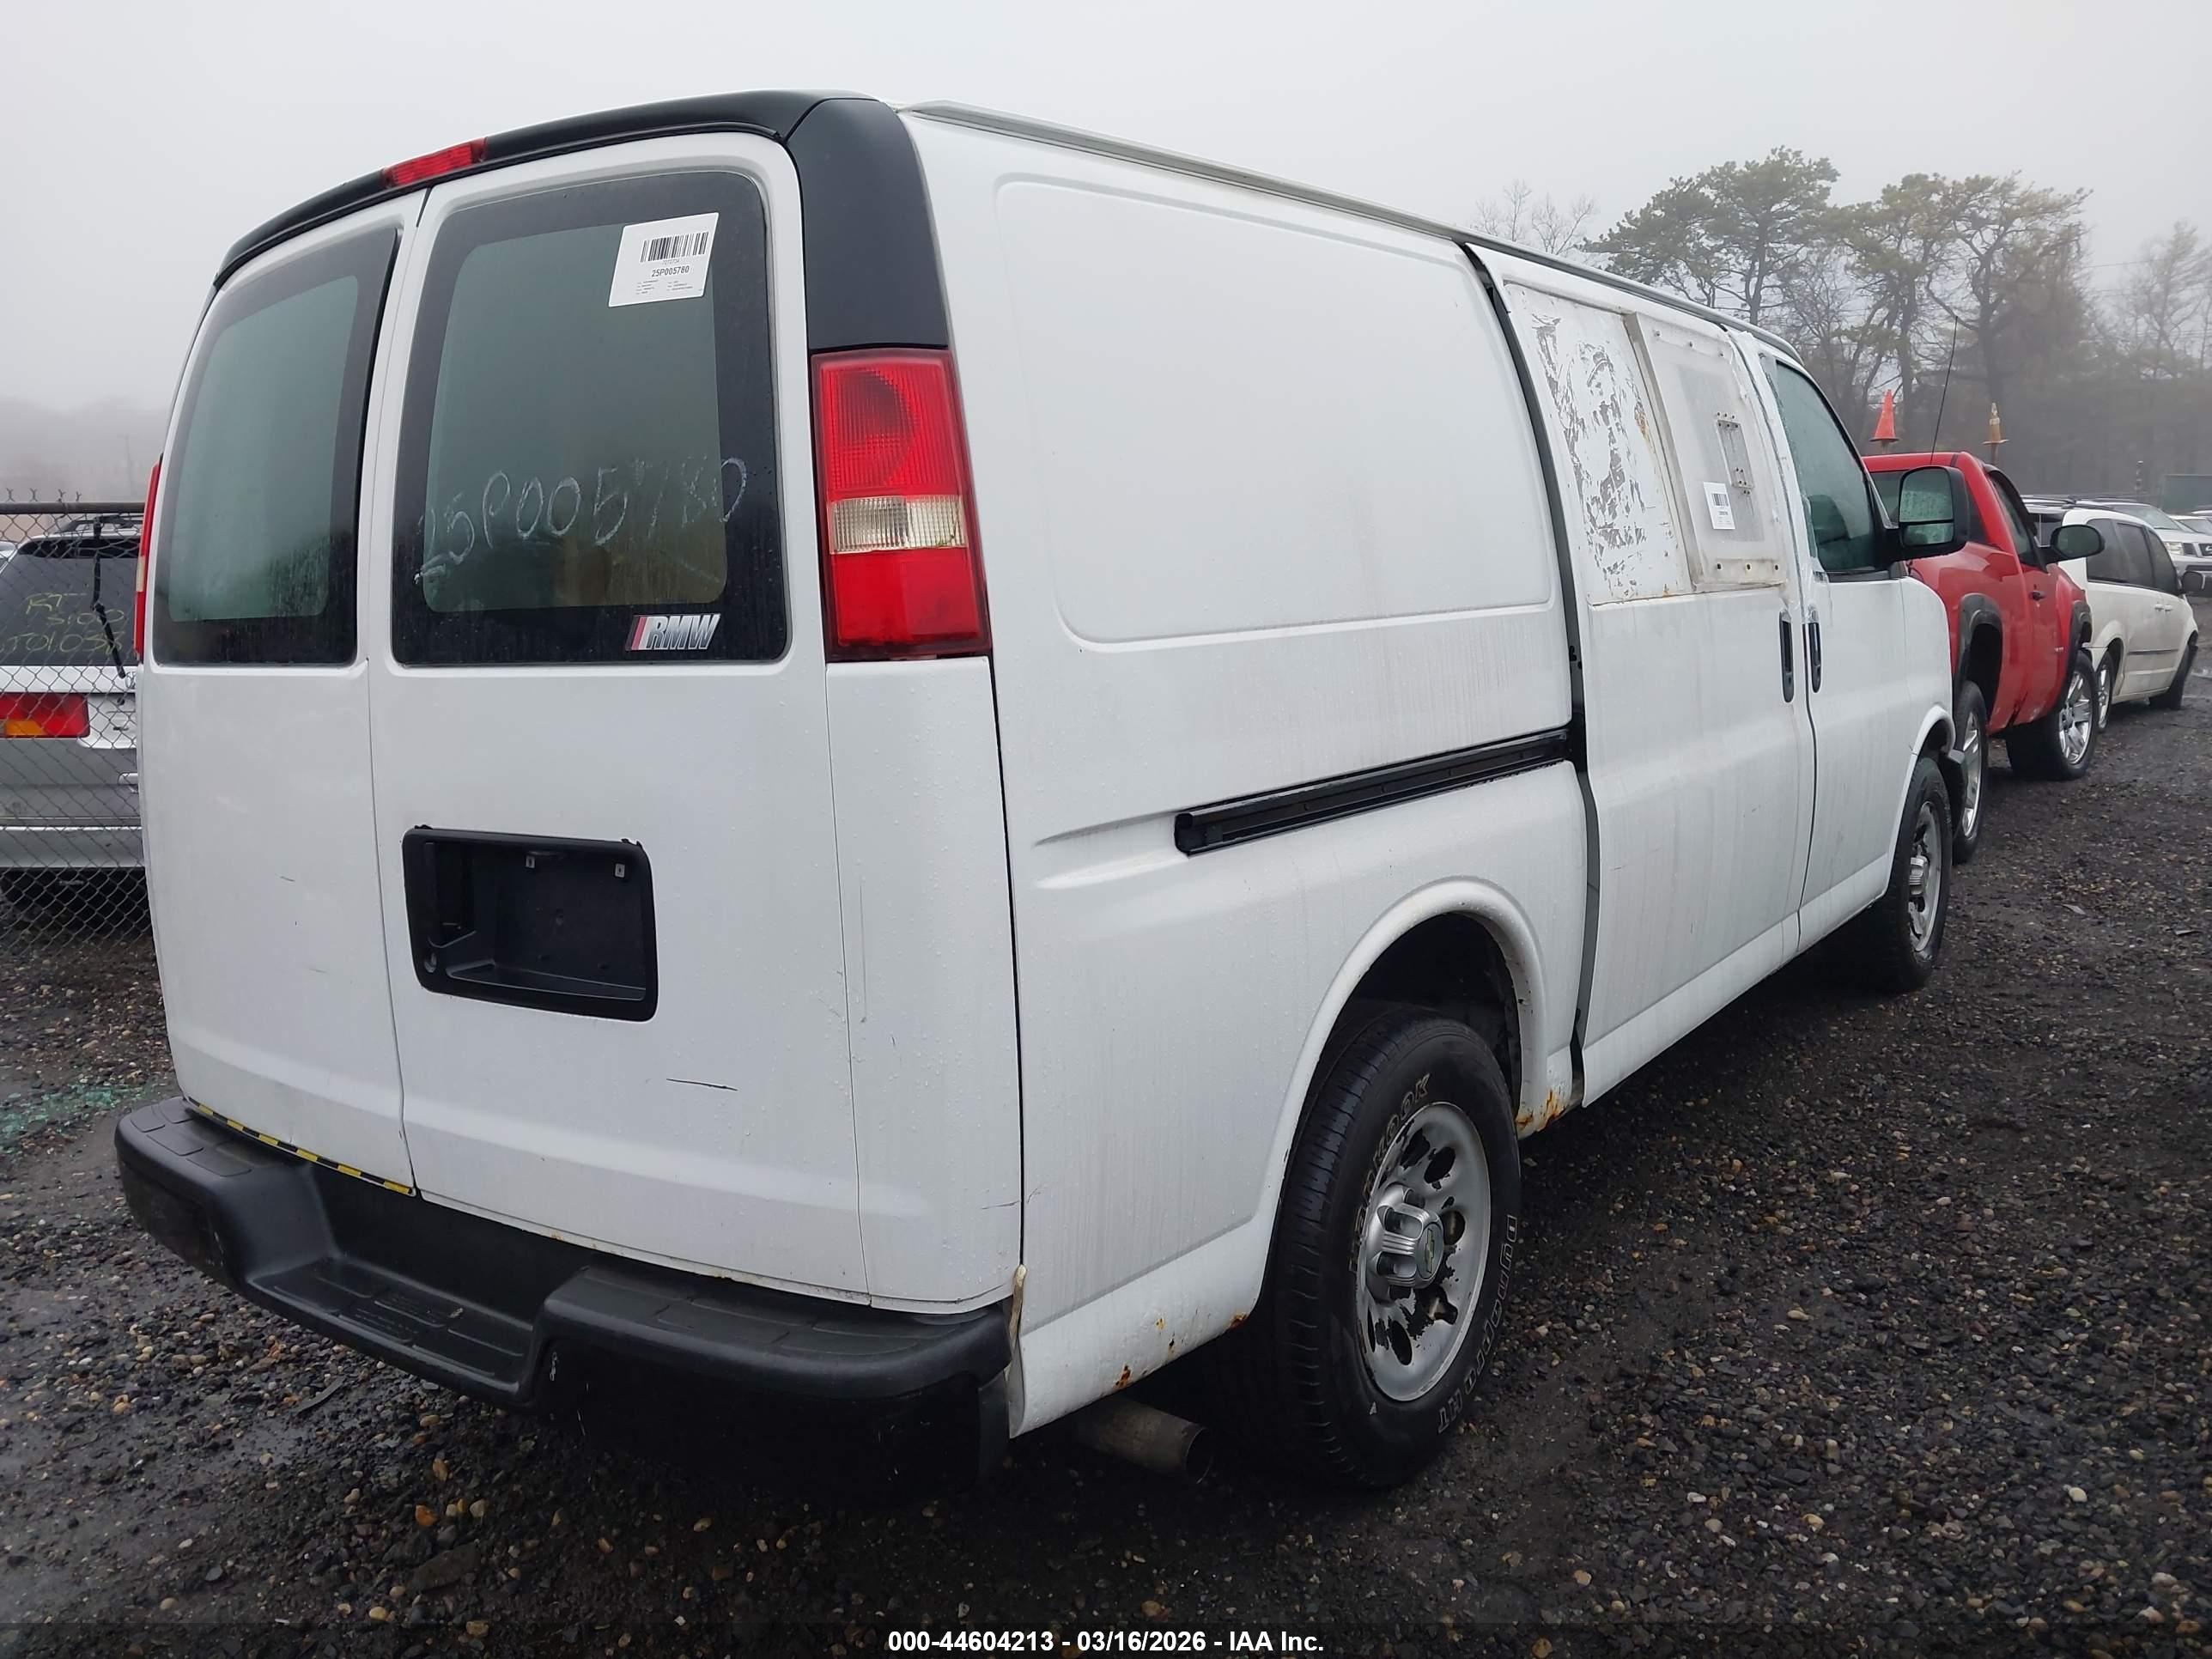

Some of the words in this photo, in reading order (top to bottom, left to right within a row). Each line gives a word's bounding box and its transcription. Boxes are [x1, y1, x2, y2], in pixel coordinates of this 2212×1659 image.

[651, 265, 690, 277] 25P005780
[644, 613, 721, 650] RMW
[1463, 1214, 1518, 1395] Dynapro
[1437, 1388, 1464, 1435] HT
